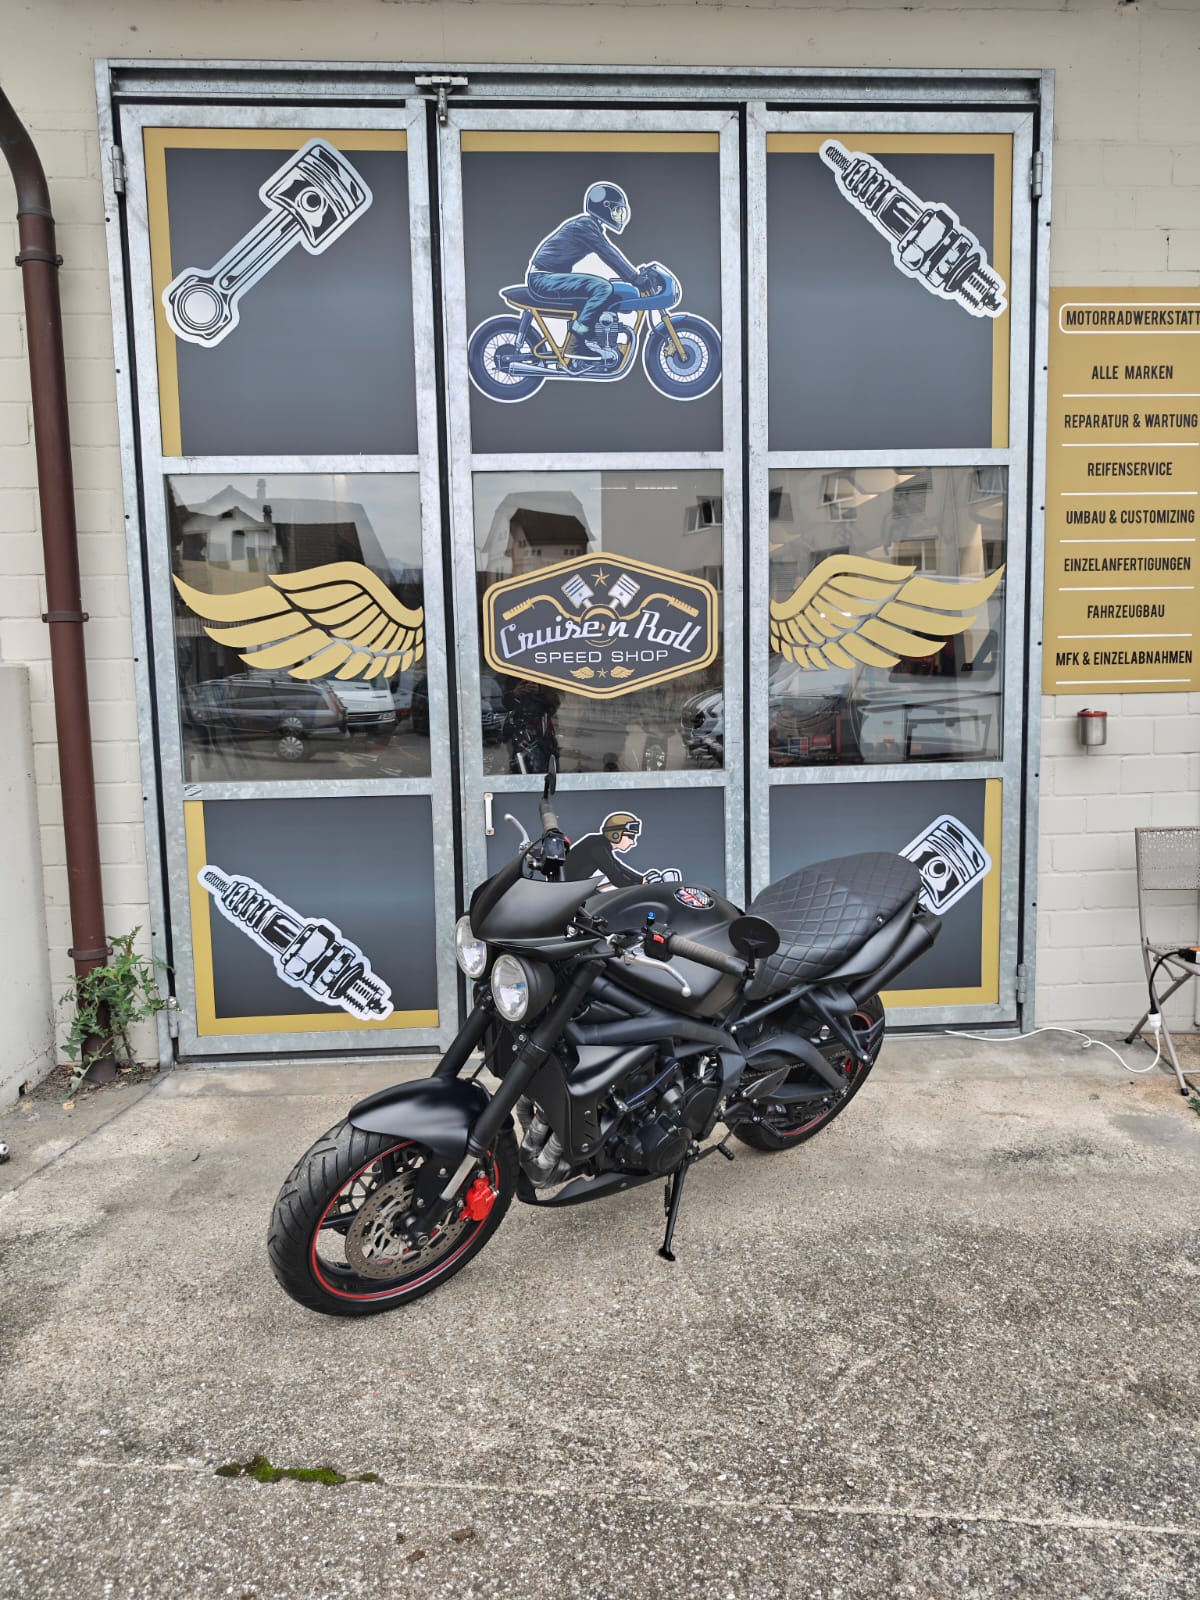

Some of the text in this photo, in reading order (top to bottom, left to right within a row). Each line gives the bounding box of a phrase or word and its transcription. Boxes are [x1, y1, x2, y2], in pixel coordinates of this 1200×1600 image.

[1066, 310, 1200, 326] MOTORRADWERKSTATT
[1091, 365, 1174, 380] ALLE MARKEN
[1064, 413, 1198, 429] REPARATUR & WARTUNG
[1087, 462, 1173, 477] REIFENSERVICE
[1066, 509, 1195, 525] UMBAU & CUSTOMIZING
[1064, 557, 1191, 572] EINZELANFERTIGUNGEN
[1087, 604, 1165, 619] FAHRZEUGBAU
[499, 615, 603, 659] Cruise
[633, 609, 702, 653] Roll
[534, 649, 668, 664] SPEED SHOP
[1056, 650, 1192, 666] MFK & EINZELABNAHMEN
